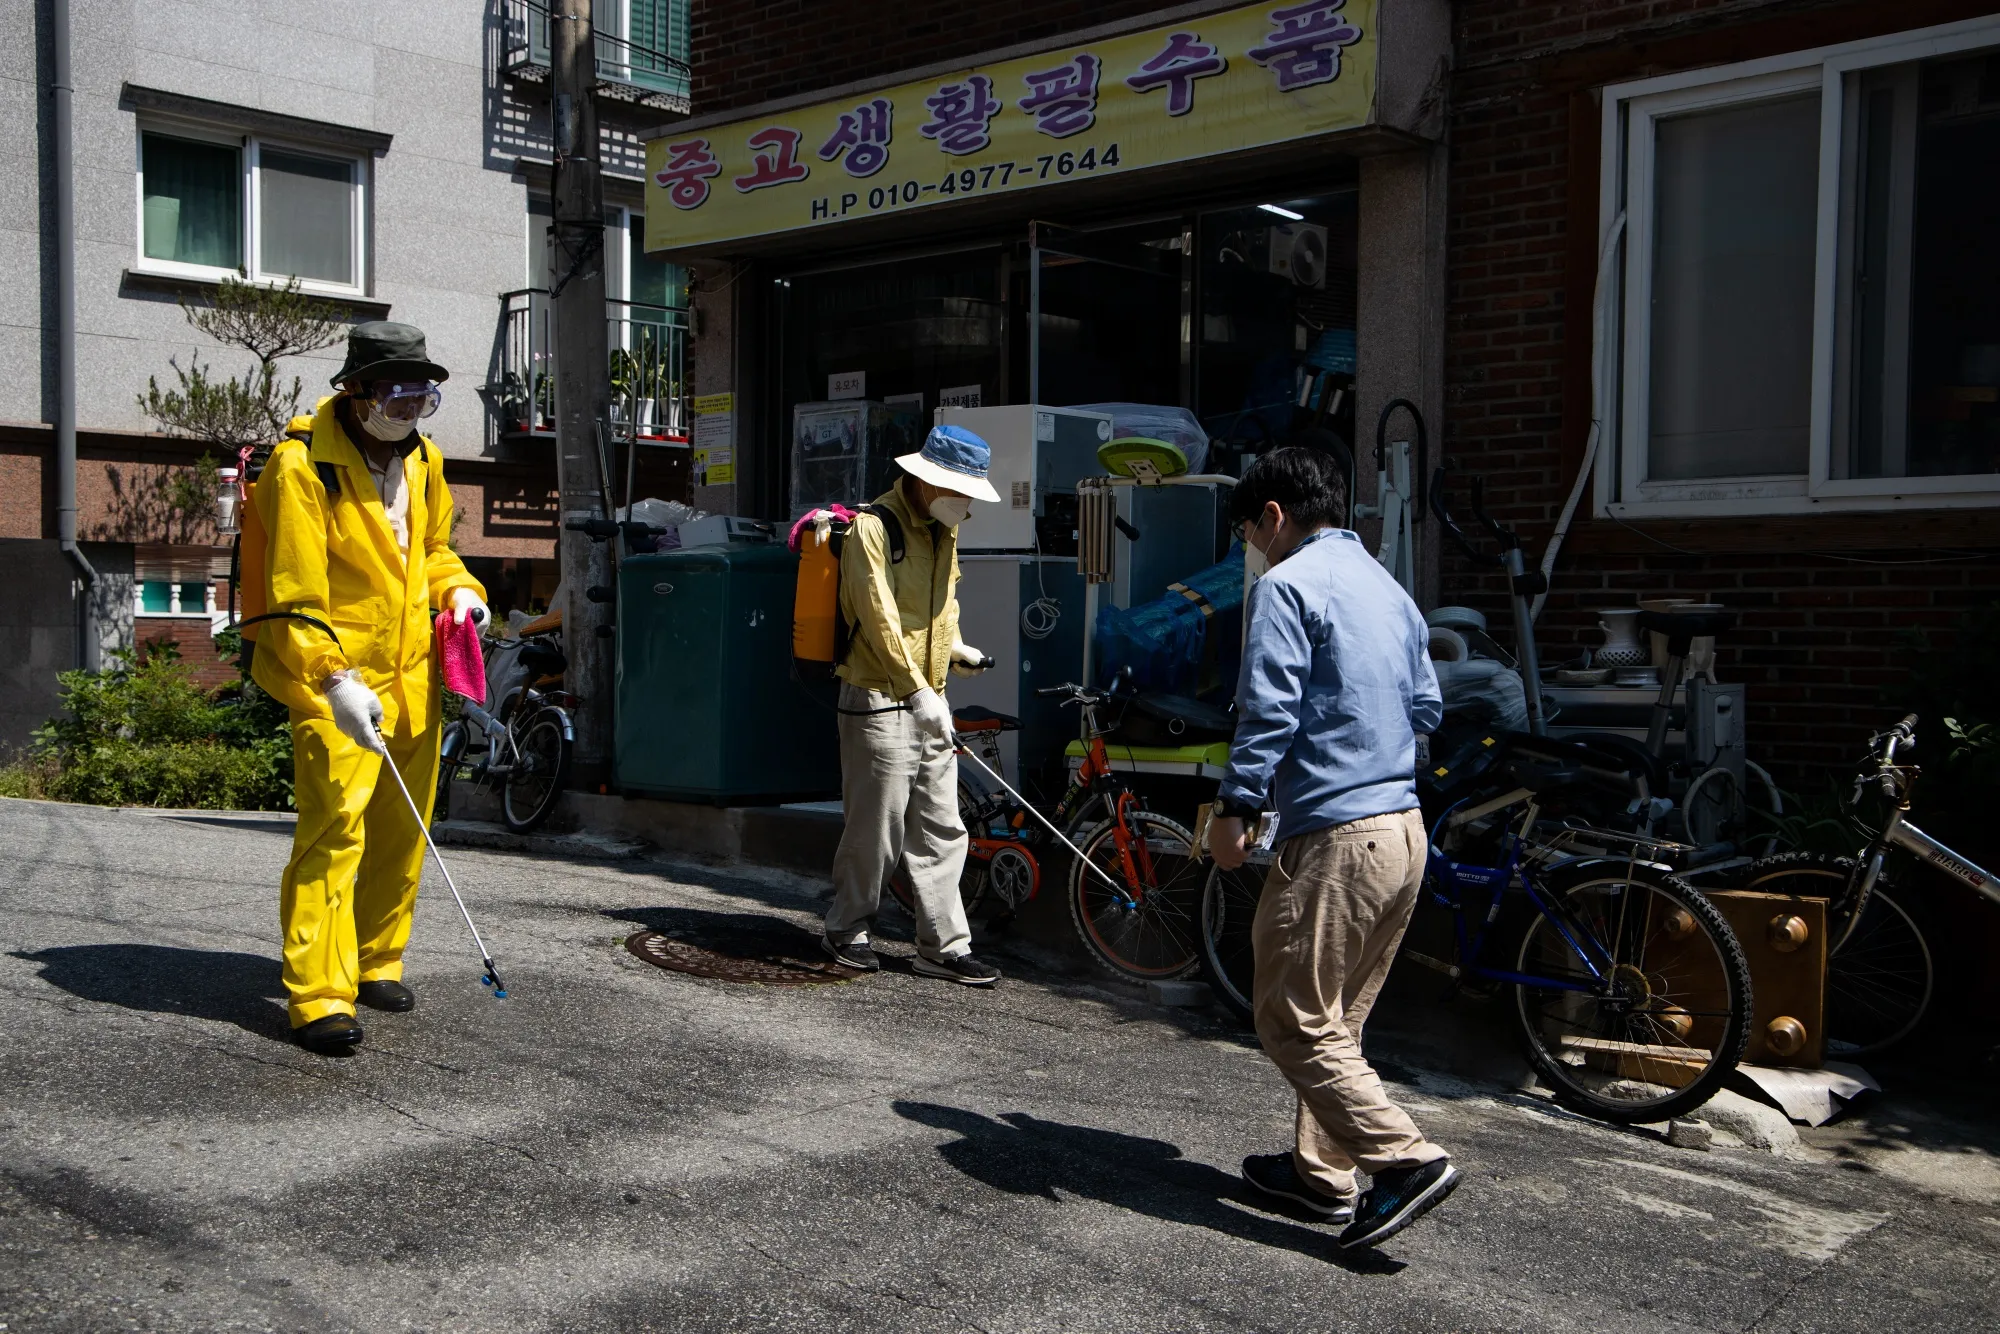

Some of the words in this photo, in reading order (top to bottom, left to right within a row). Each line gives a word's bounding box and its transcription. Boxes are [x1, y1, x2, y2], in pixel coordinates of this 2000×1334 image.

[812, 195, 858, 220] H.P
[868, 143, 1120, 210] 010-4977-7644
[834, 379, 860, 391] 유모차
